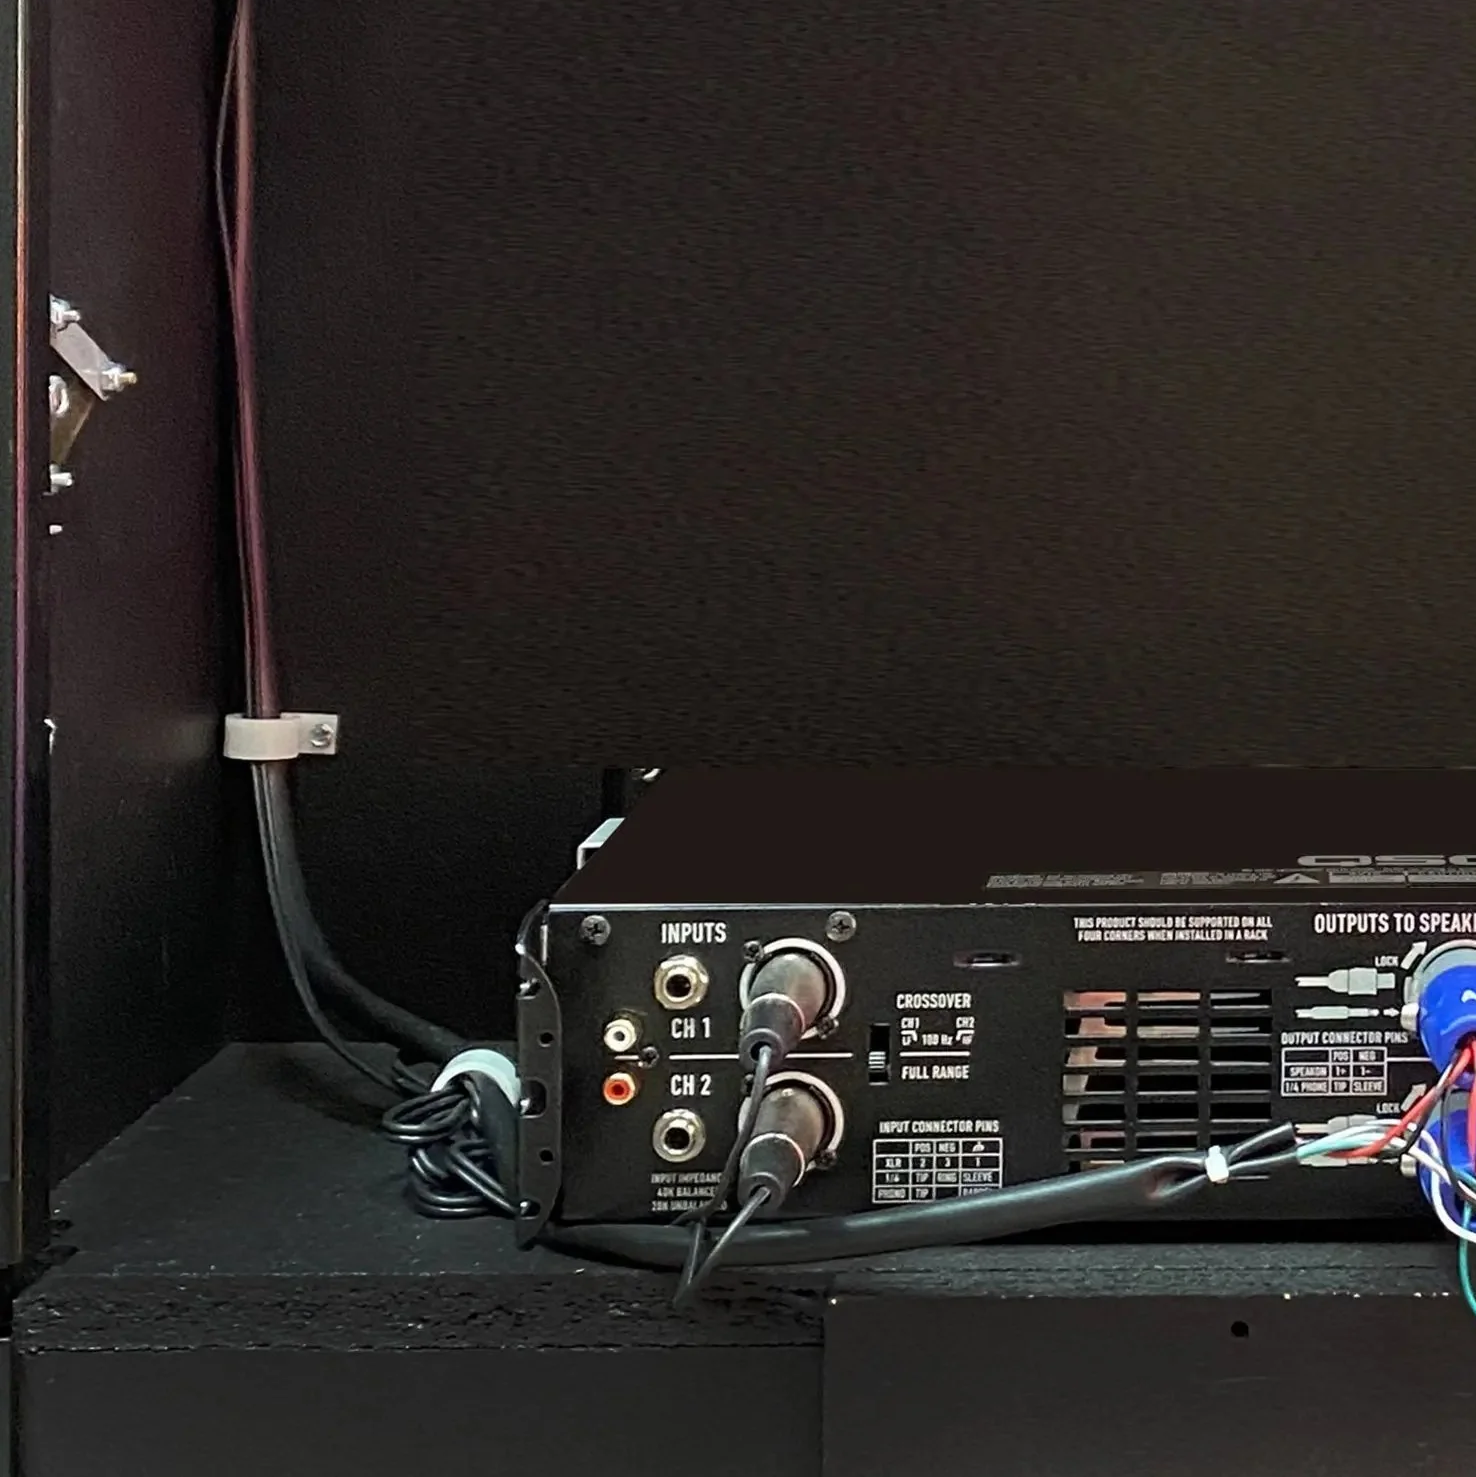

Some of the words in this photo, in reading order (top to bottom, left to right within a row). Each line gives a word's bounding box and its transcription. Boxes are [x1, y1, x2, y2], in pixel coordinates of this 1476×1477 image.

[1074, 917, 1094, 929] THIS
[1096, 917, 1136, 928] PRODUCT
[1138, 916, 1173, 928] SHOULD
[1175, 916, 1186, 928] BE
[1188, 916, 1240, 928] SUPPORTED
[1256, 916, 1273, 928] ALL
[1314, 913, 1389, 934] OUTPUTS
[1394, 913, 1415, 933] TO
[660, 922, 727, 944] INPUTS
[1078, 930, 1102, 942] FOUR
[1104, 930, 1146, 941] CORNERS
[1147, 930, 1173, 941] WHEN
[1175, 929, 1223, 941] INSTALLED
[1224, 929, 1234, 940] IN
[1235, 929, 1242, 940] A
[1243, 929, 1268, 940] RACK
[1375, 956, 1399, 967] LOCK
[896, 993, 972, 1009] CROSSOVER
[670, 1017, 696, 1039] CH
[702, 1017, 711, 1038] 1
[901, 1017, 919, 1029] CH1
[956, 1016, 975, 1029] CH2
[922, 1034, 939, 1045] 100
[1281, 1031, 1319, 1044] OUTPUT
[1321, 1031, 1382, 1043] CONNECTOR
[1384, 1031, 1408, 1043] PINS
[901, 1065, 930, 1080] FULL
[931, 1065, 970, 1079] RANGE
[670, 1074, 695, 1096] CH
[700, 1074, 711, 1096] 2
[1376, 1103, 1400, 1114] LOCK
[879, 1121, 911, 1134] INPUT
[912, 1120, 973, 1133] CONNECTOR
[974, 1120, 1000, 1132] PINS
[919, 1158, 927, 1168] 2
[962, 1172, 993, 1183] SLEEVE
